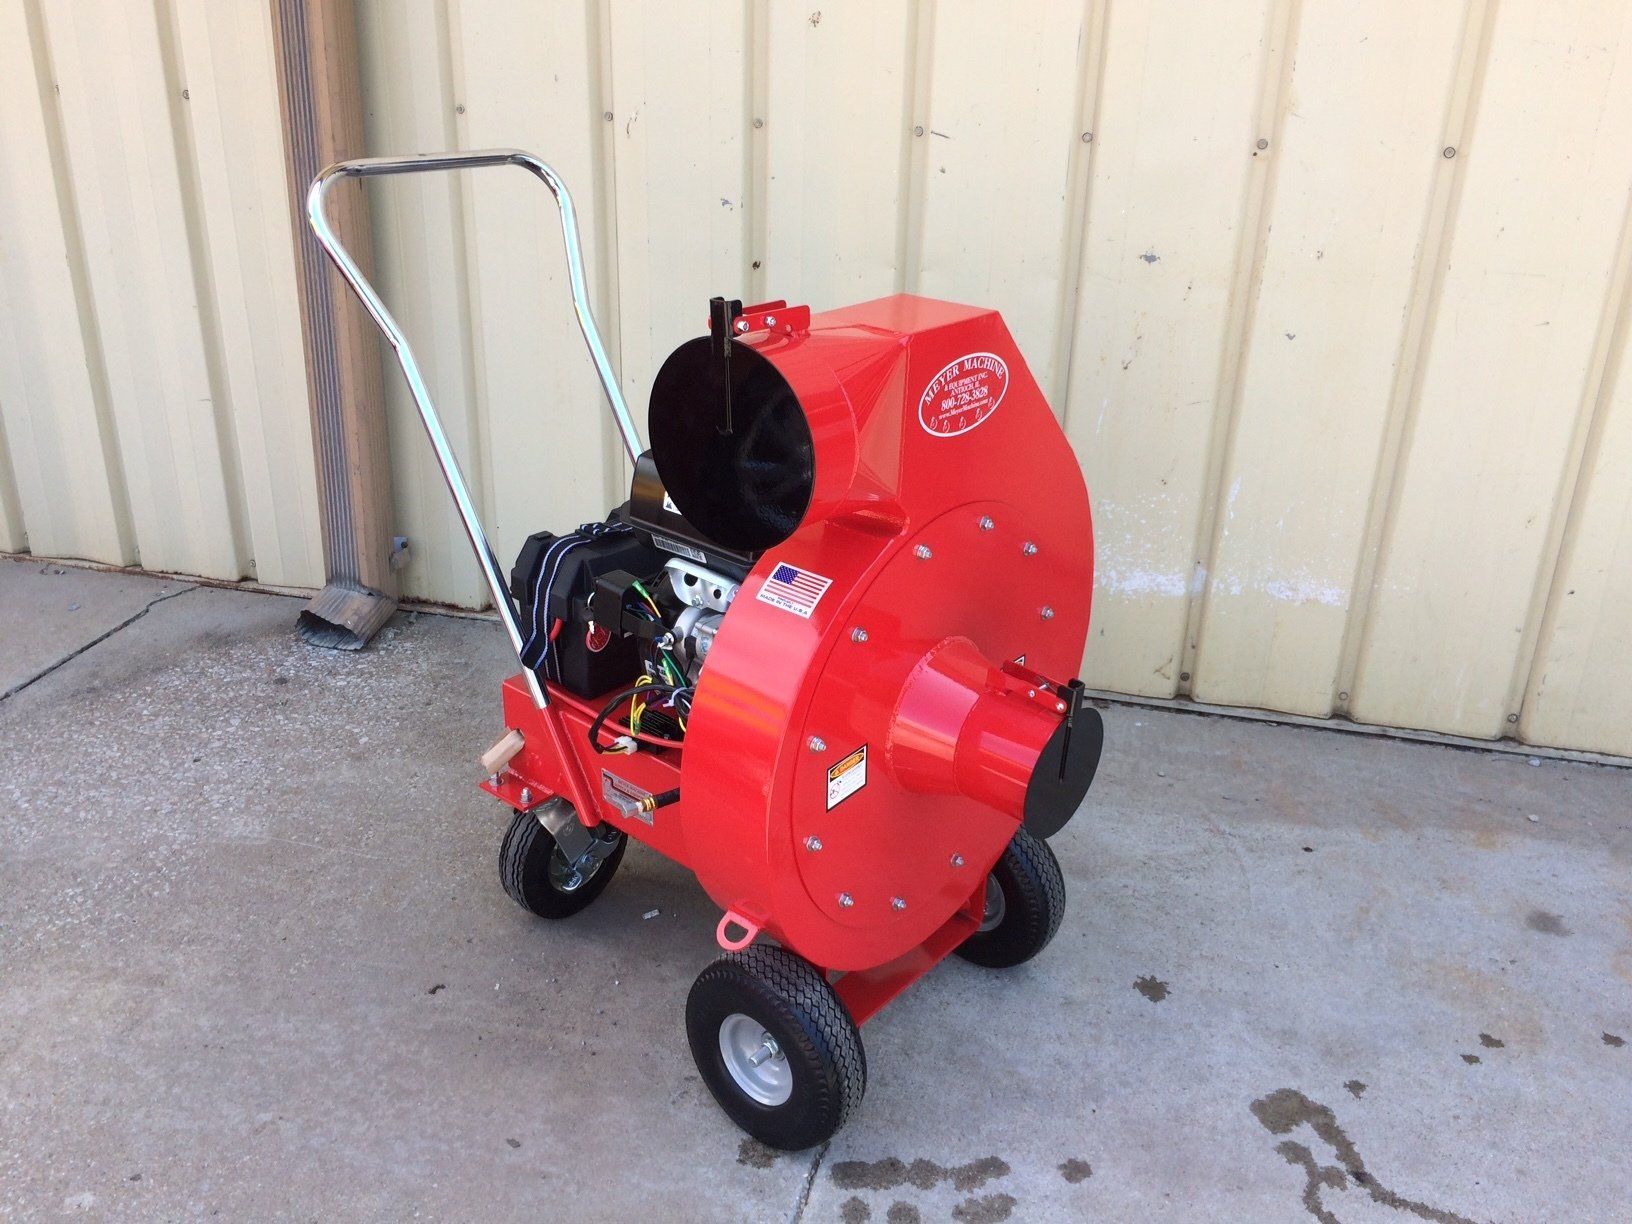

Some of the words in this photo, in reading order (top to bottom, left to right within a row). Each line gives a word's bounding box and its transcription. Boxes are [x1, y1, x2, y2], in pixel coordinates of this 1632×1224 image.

[925, 365, 960, 406] MEYER
[963, 356, 1005, 380] MACHINE
[948, 375, 977, 391] EQUIPMENT
[941, 385, 989, 412] 800-728-3828
[760, 594, 777, 603] MADE
[783, 602, 793, 610] THE
